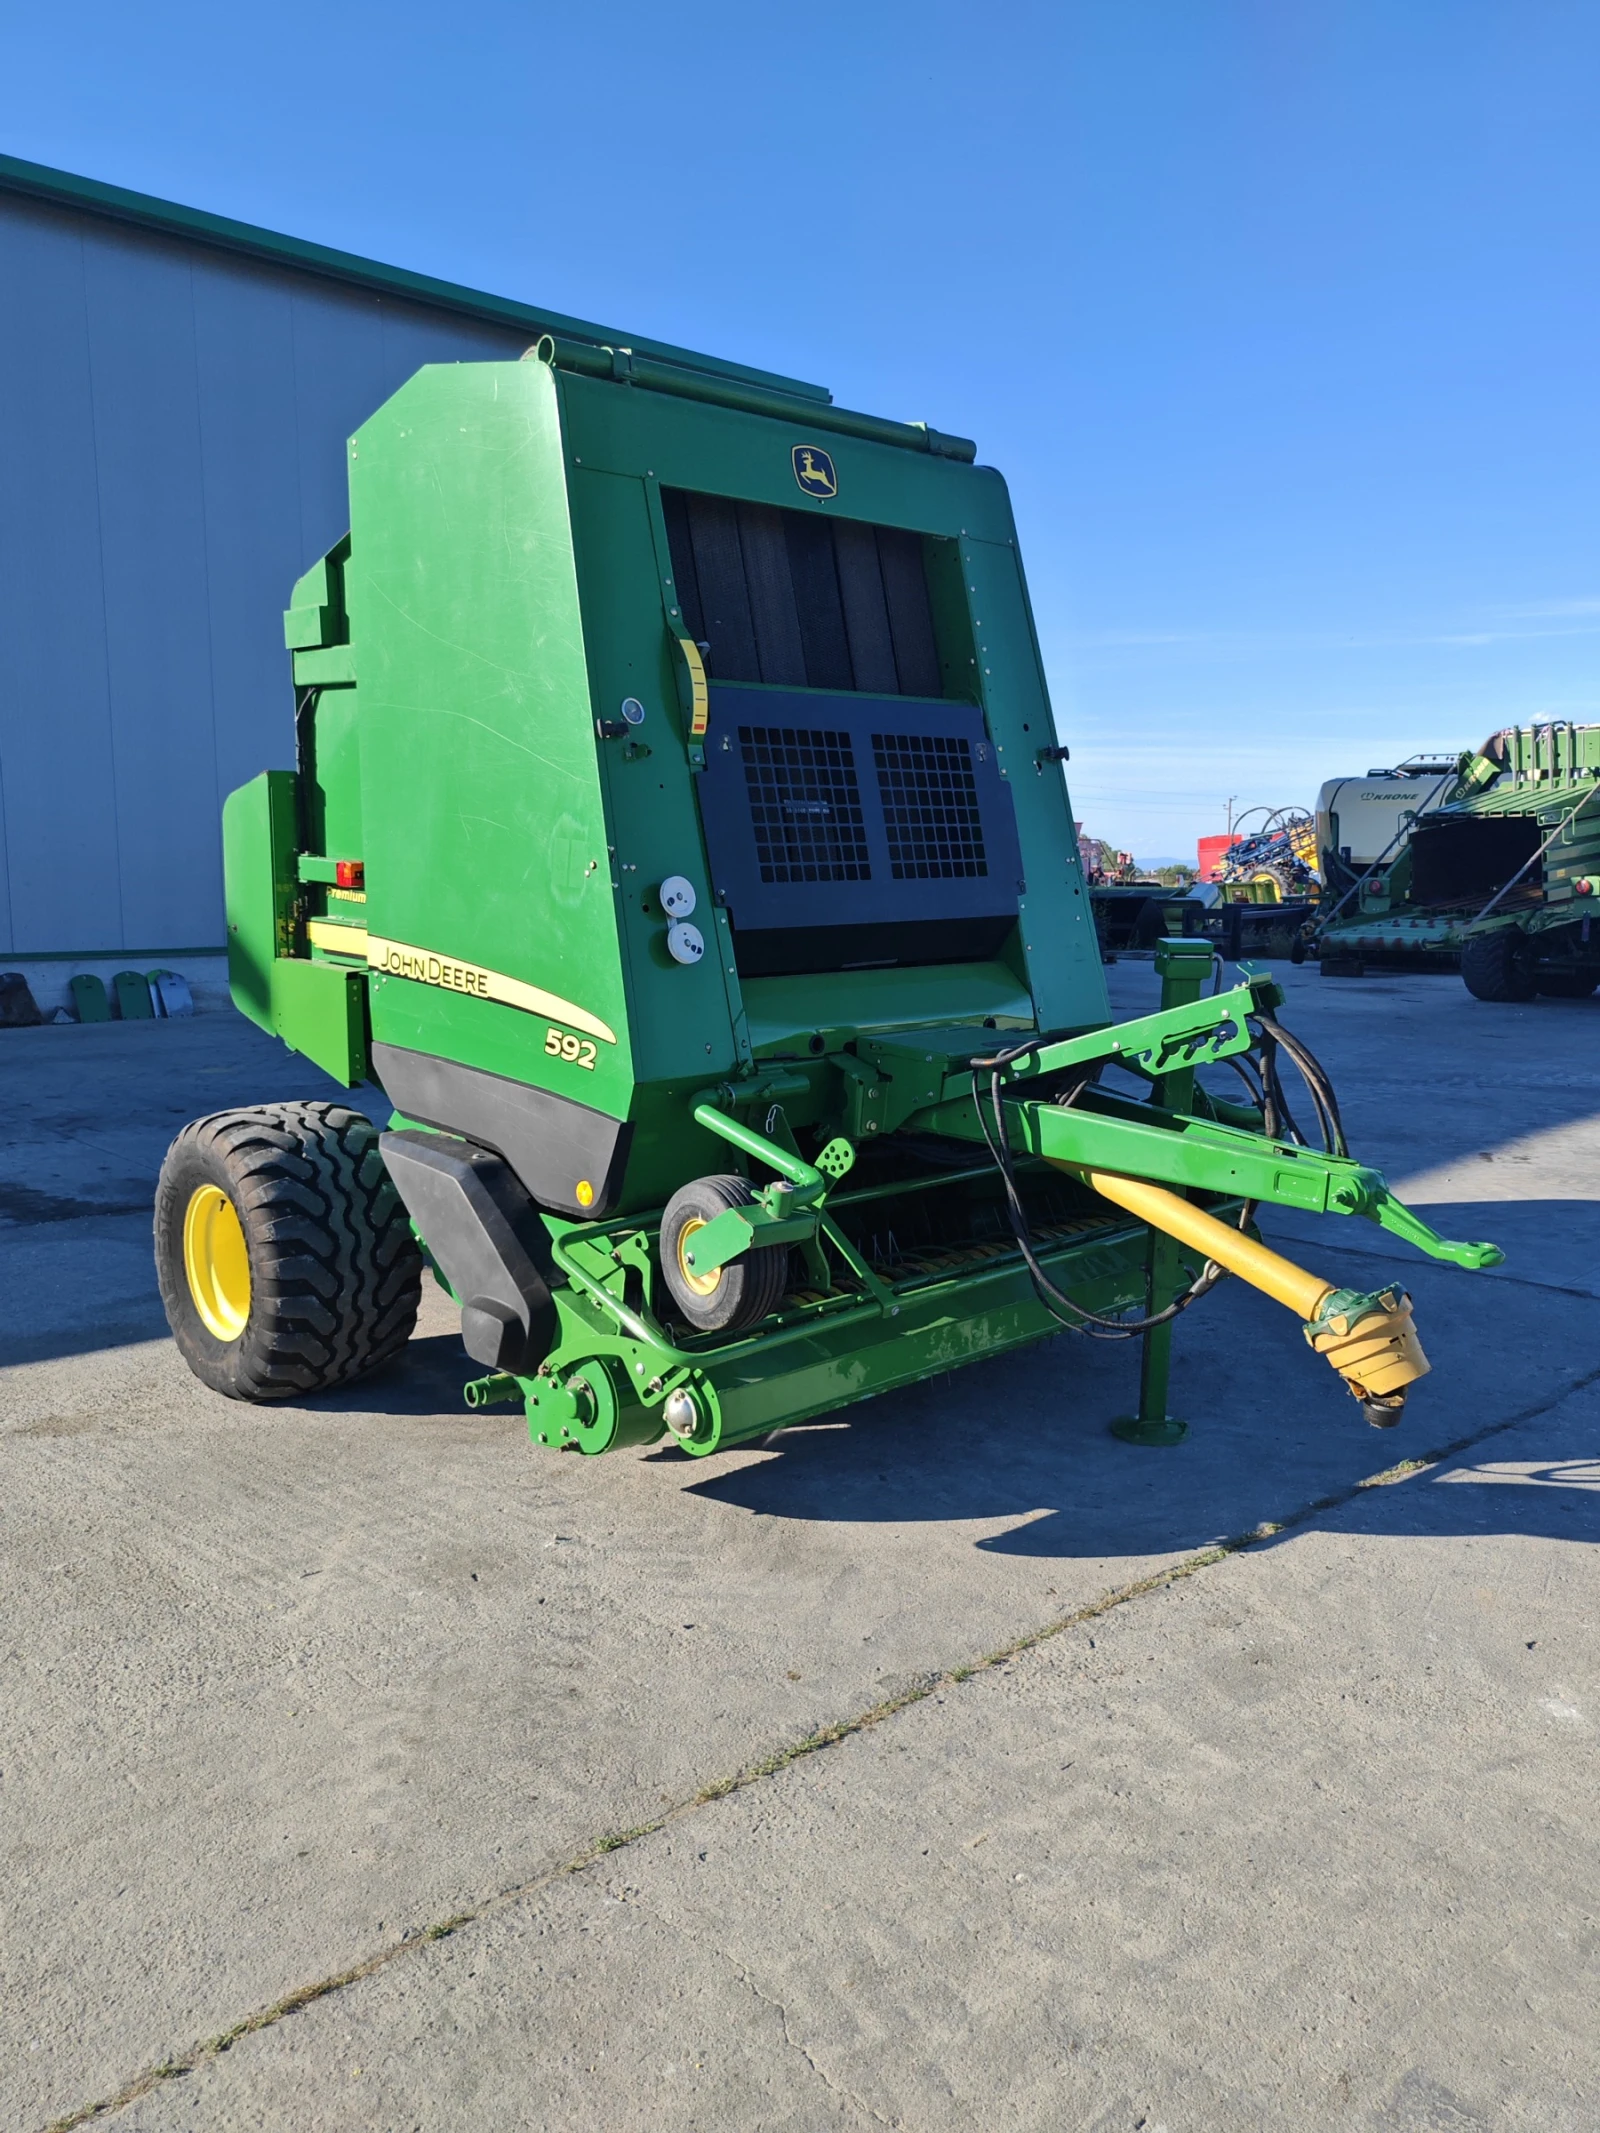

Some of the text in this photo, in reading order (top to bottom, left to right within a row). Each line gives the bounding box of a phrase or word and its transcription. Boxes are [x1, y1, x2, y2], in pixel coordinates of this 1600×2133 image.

[1373, 793, 1418, 801] KRONE
[326, 886, 366, 904] Premium
[381, 946, 488, 993] JOHN DEERE
[544, 1028, 598, 1071] 592
